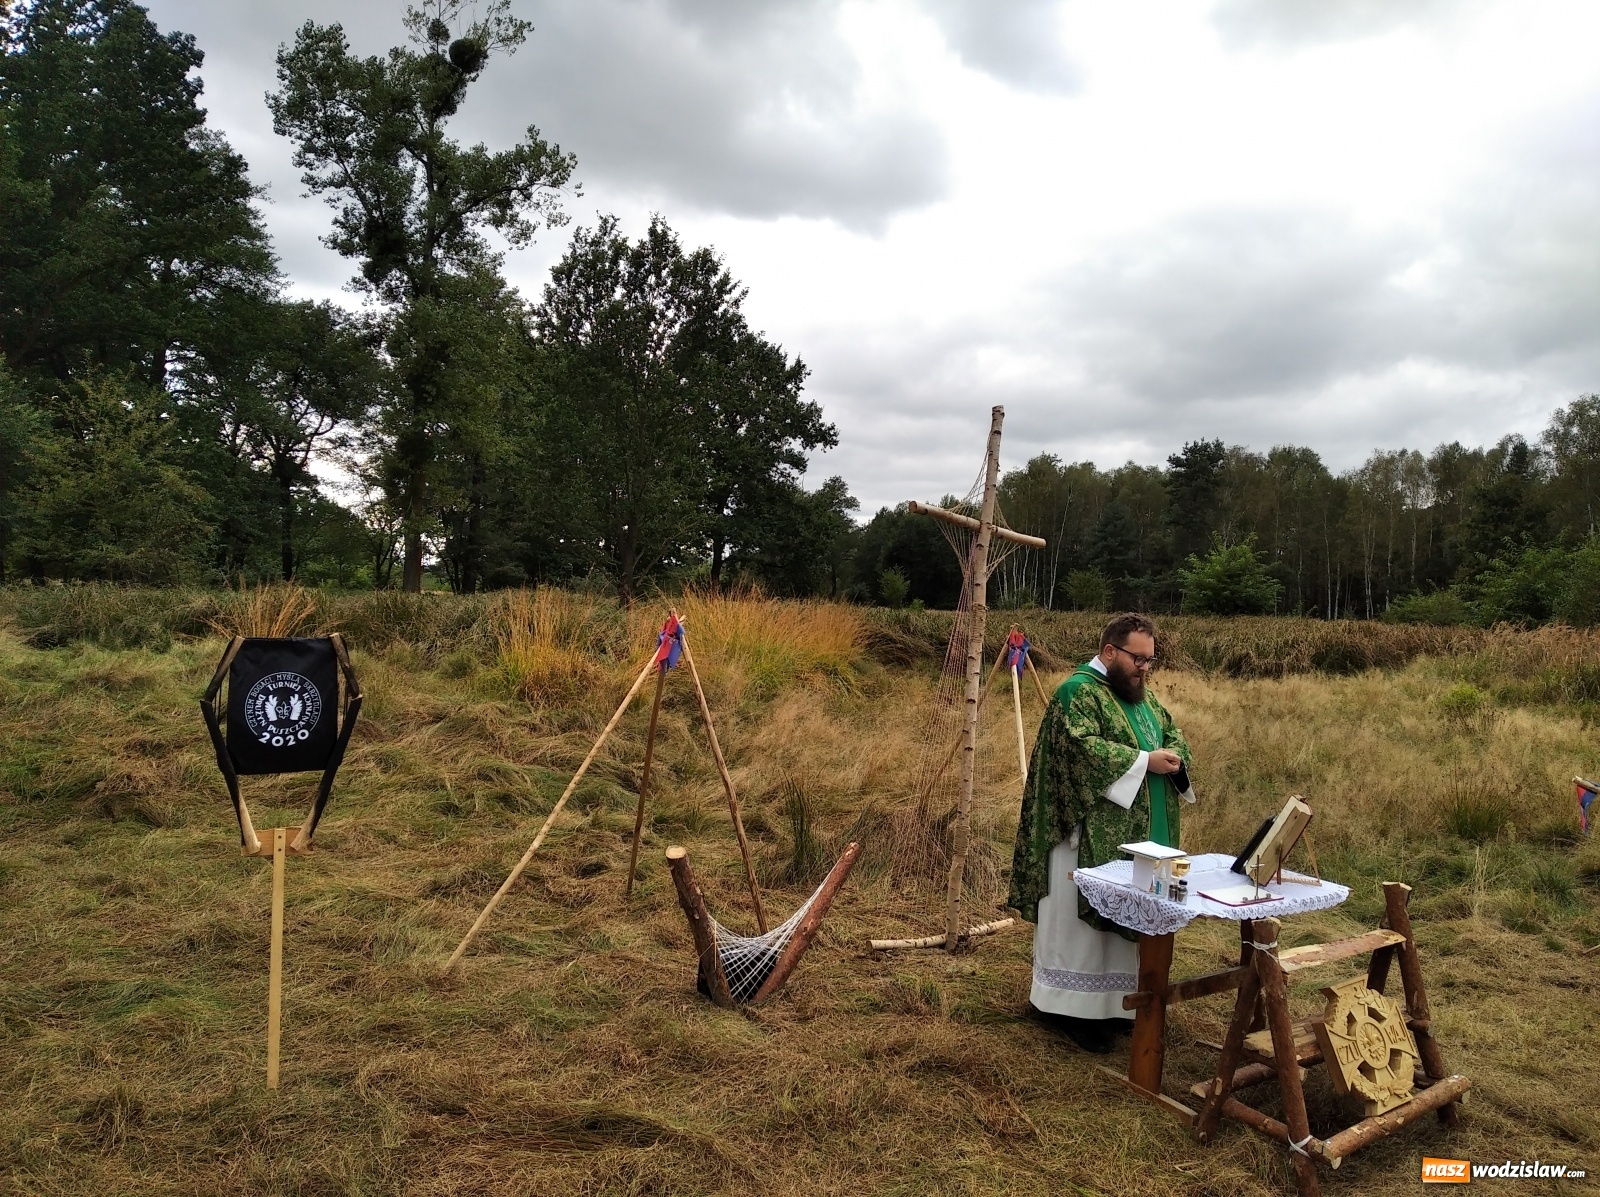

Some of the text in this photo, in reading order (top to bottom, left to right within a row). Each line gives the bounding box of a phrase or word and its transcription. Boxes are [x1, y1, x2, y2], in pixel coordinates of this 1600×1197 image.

[266, 681, 302, 692] TURNIEJ
[247, 698, 258, 728] CZYNEM
[254, 694, 268, 727] DRUŻYN
[258, 729, 309, 747] 2020
